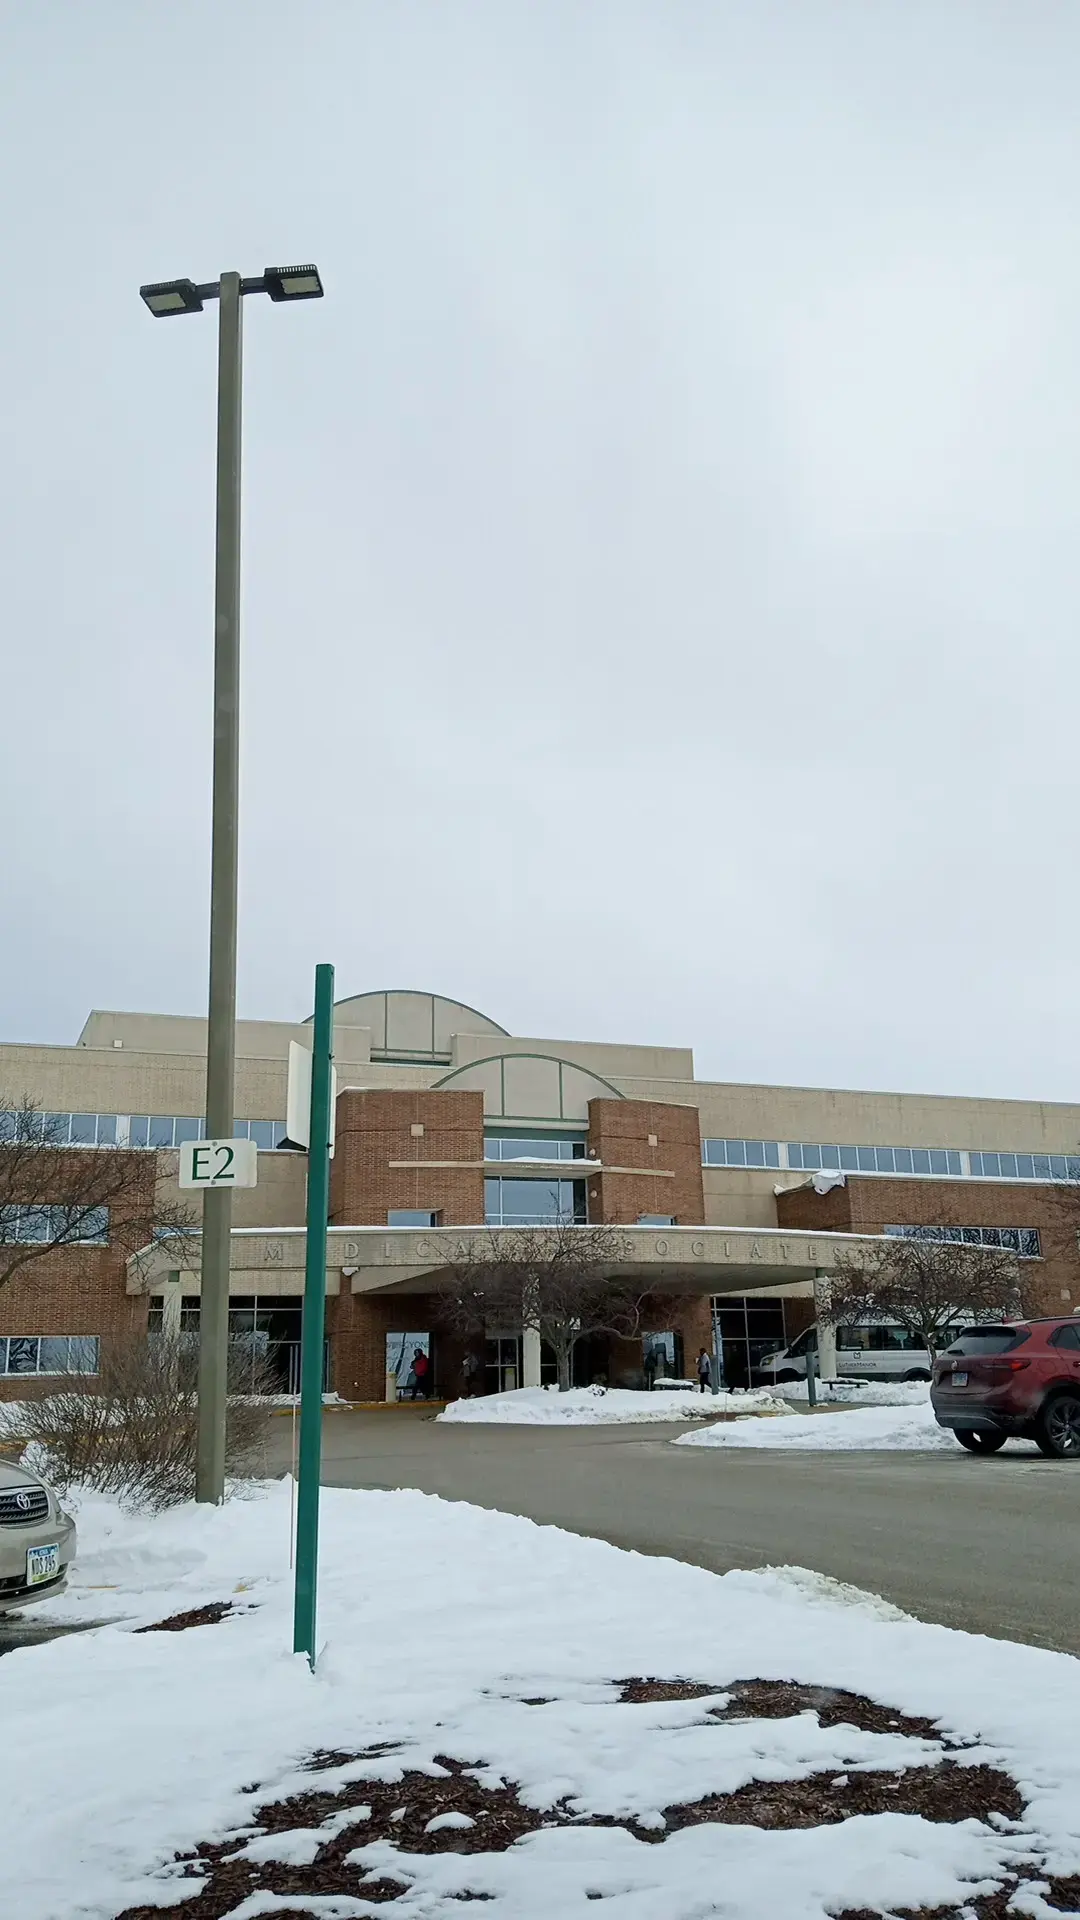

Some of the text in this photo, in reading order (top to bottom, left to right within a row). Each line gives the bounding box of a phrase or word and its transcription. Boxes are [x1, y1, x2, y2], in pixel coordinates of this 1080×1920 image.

[192, 1146, 235, 1181] E2
[264, 1238, 841, 1262] MDICA SOCIATES
